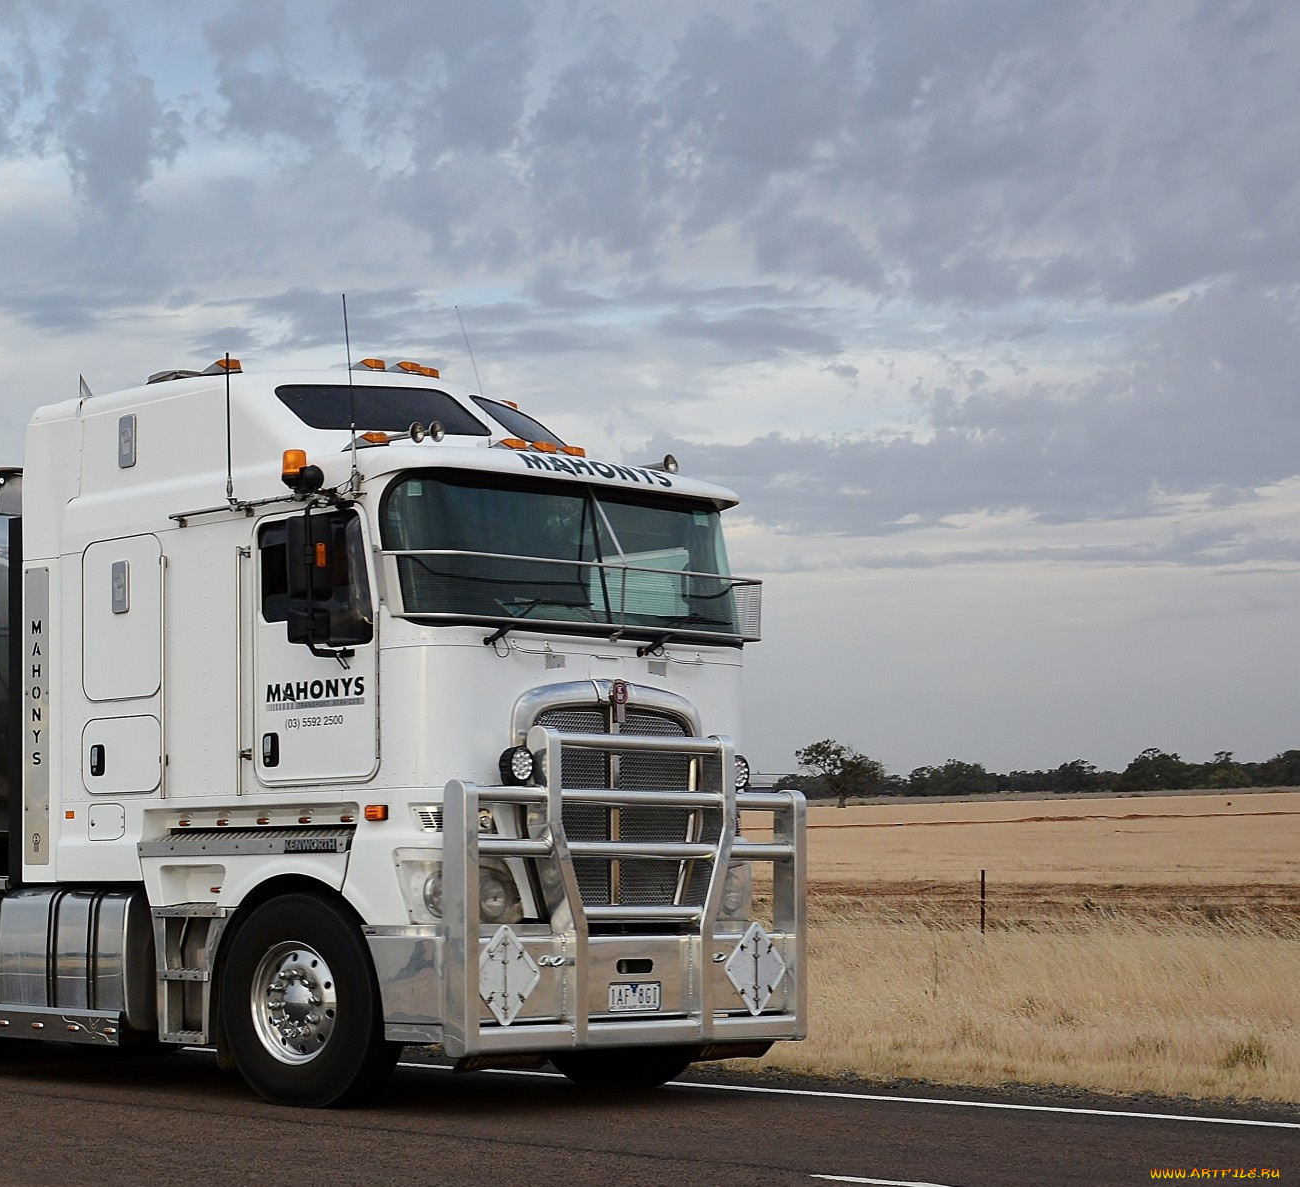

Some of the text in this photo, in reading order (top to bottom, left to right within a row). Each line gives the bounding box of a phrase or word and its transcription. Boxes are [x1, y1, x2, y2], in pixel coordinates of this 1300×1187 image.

[516, 453, 672, 487] MAHONYS
[31, 620, 42, 765] MAHONYS
[266, 676, 364, 702] MAHONYS
[285, 714, 344, 730] (03) 5592 2500
[284, 839, 336, 850] KENWORTH
[611, 988, 630, 1005] 1AF
